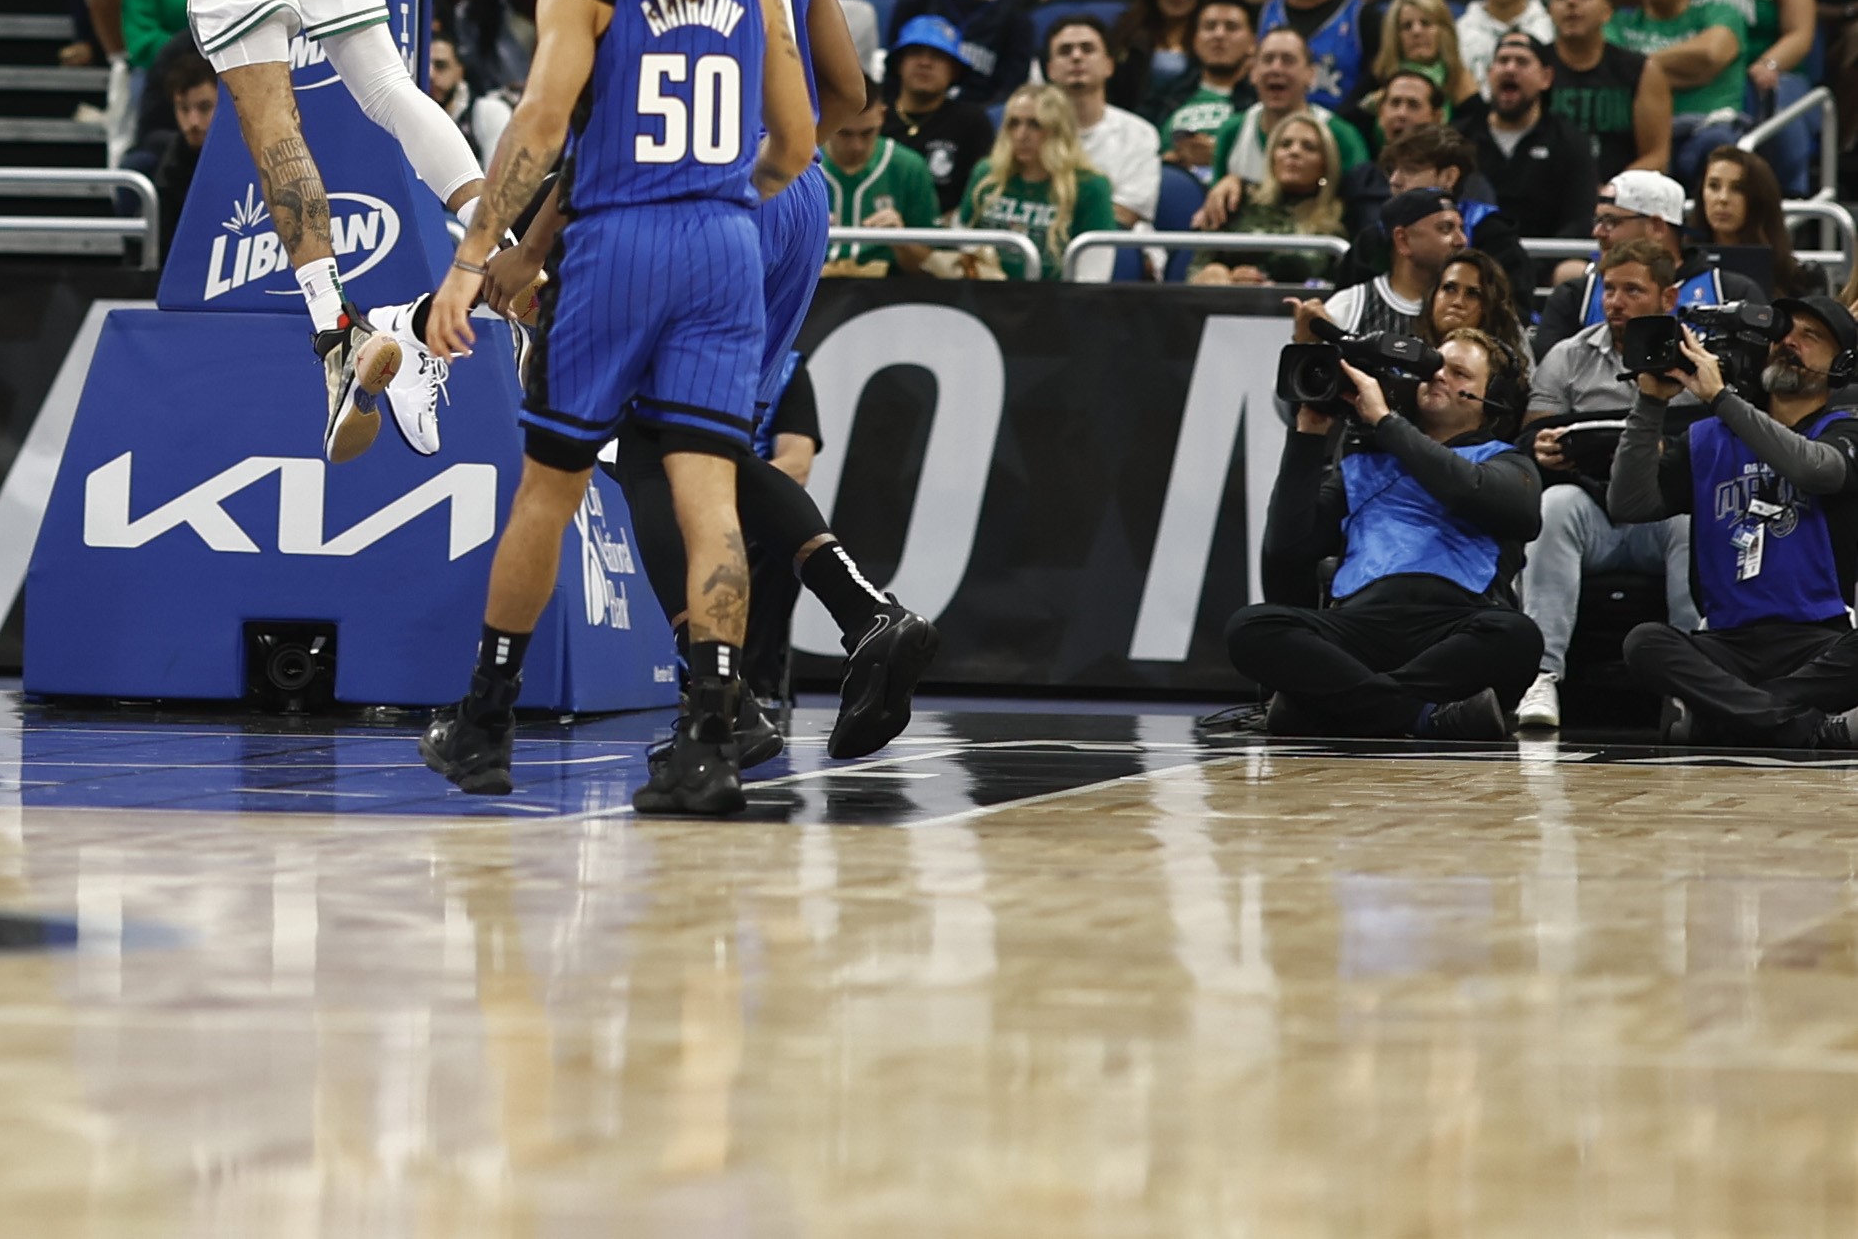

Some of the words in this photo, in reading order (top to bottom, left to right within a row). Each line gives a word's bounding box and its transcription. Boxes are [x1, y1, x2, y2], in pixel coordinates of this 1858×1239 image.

[635, 53, 741, 165] 50
[203, 210, 382, 301] LIBAN
[83, 450, 499, 562] KIA
[606, 579, 631, 630] Bank
